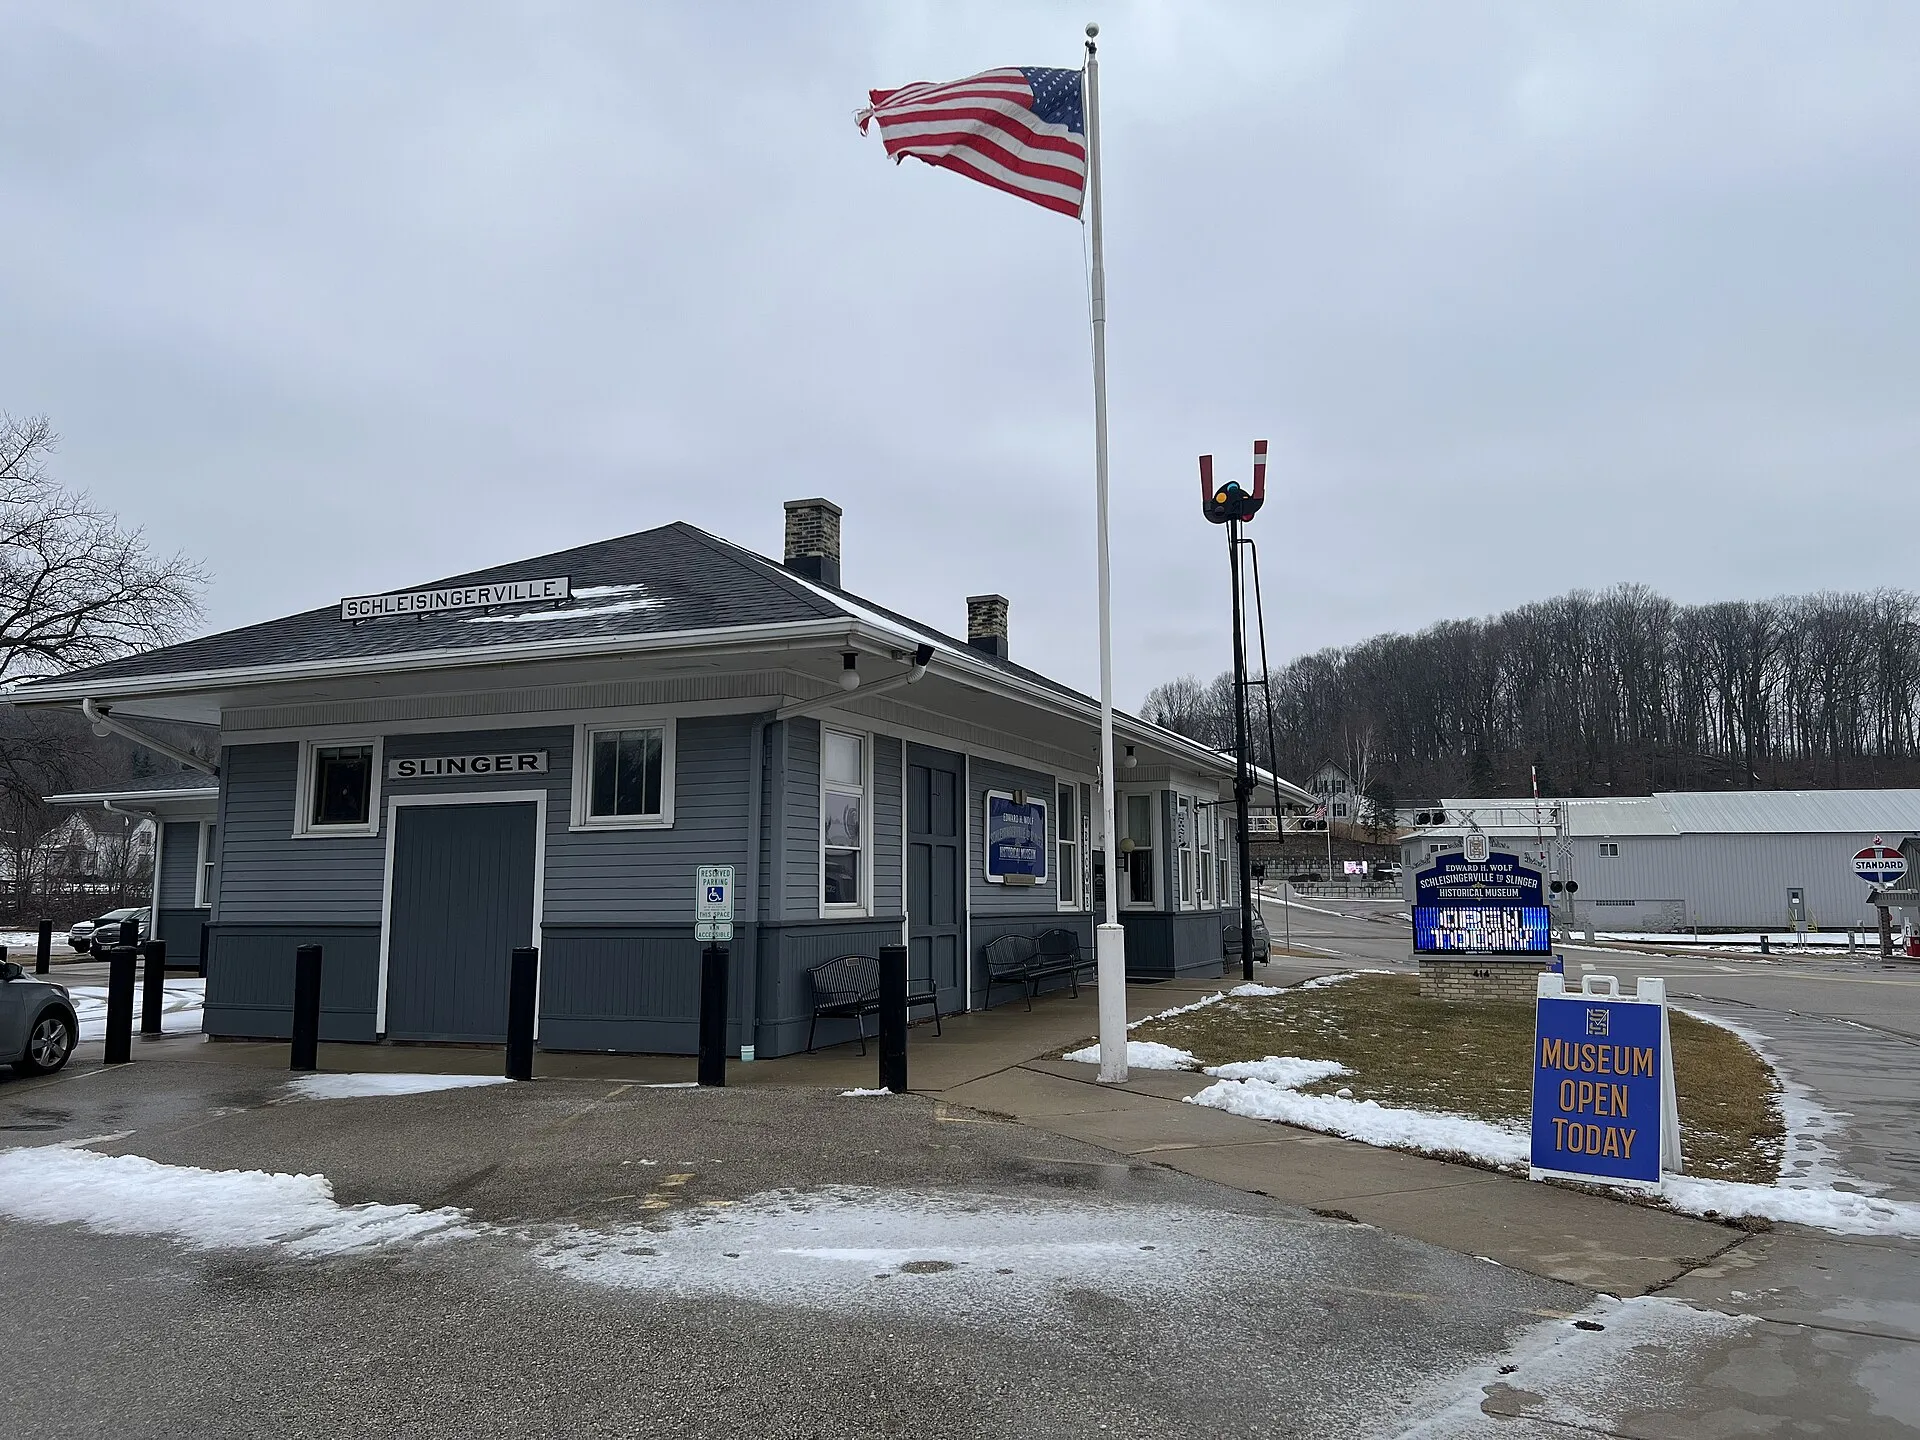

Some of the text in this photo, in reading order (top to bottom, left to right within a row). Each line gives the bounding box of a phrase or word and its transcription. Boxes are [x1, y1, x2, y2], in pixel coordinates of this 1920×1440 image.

[347, 581, 562, 616] SCHLEISINGERVILLE.
[397, 754, 539, 777] SLINGER
[1445, 864, 1513, 872] EDWARD H. WOLF
[1855, 861, 1904, 869] STANDARD
[701, 869, 731, 877] RESERVED
[703, 878, 729, 886] PARKING
[1420, 873, 1494, 889] SCHLEISINGERVILLE
[1505, 874, 1538, 889] SLINGER
[1439, 888, 1519, 897] HISTORICAL MUSEUM
[1472, 969, 1490, 978] 414
[1541, 1037, 1653, 1077] MUSEUM
[1559, 1079, 1629, 1118] OPEN
[1551, 1117, 1636, 1159] TODAY
